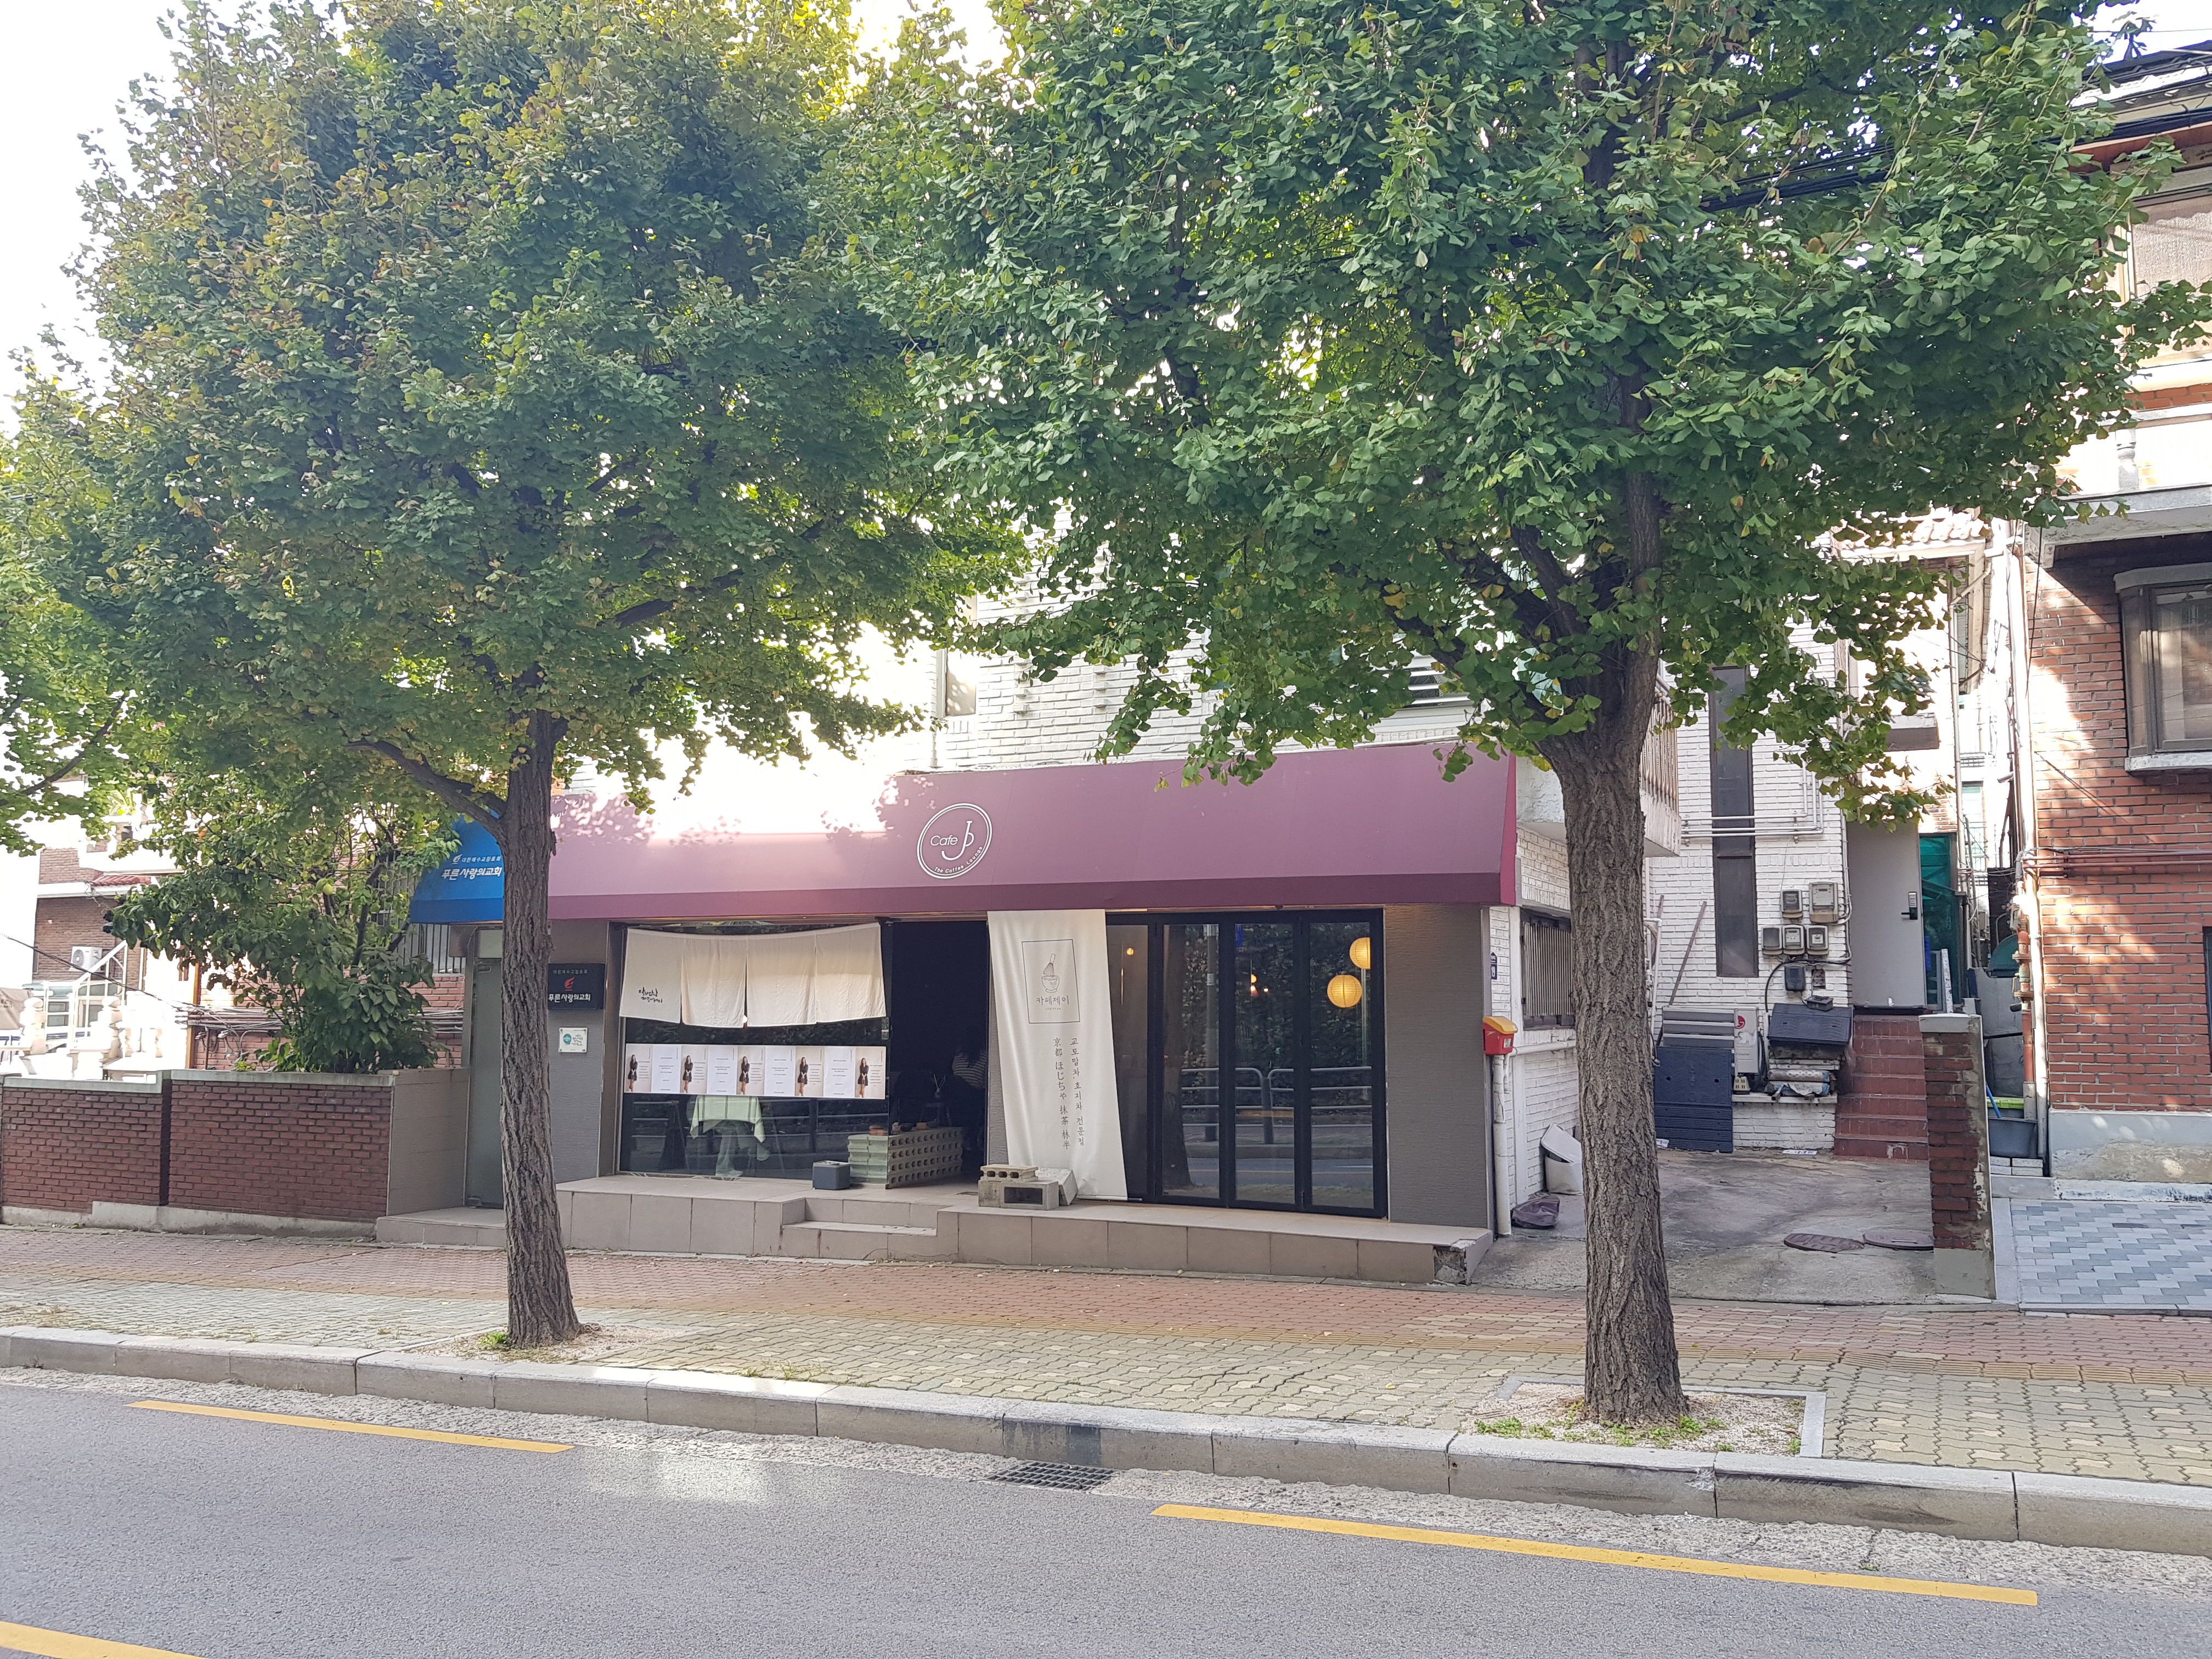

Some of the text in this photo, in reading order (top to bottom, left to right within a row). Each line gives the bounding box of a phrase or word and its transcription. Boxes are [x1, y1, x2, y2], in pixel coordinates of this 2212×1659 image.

[930, 835, 958, 846] Cafe
[945, 865, 964, 873] Coffee
[966, 846, 983, 865] Lounge
[1036, 995, 1069, 1006] 카페제이
[1053, 1037, 1063, 1057] 京都
[1059, 1104, 1069, 1125] 抹茶
[1061, 1129, 1070, 1150] 林半
[1076, 1116, 1085, 1146] 전문점
